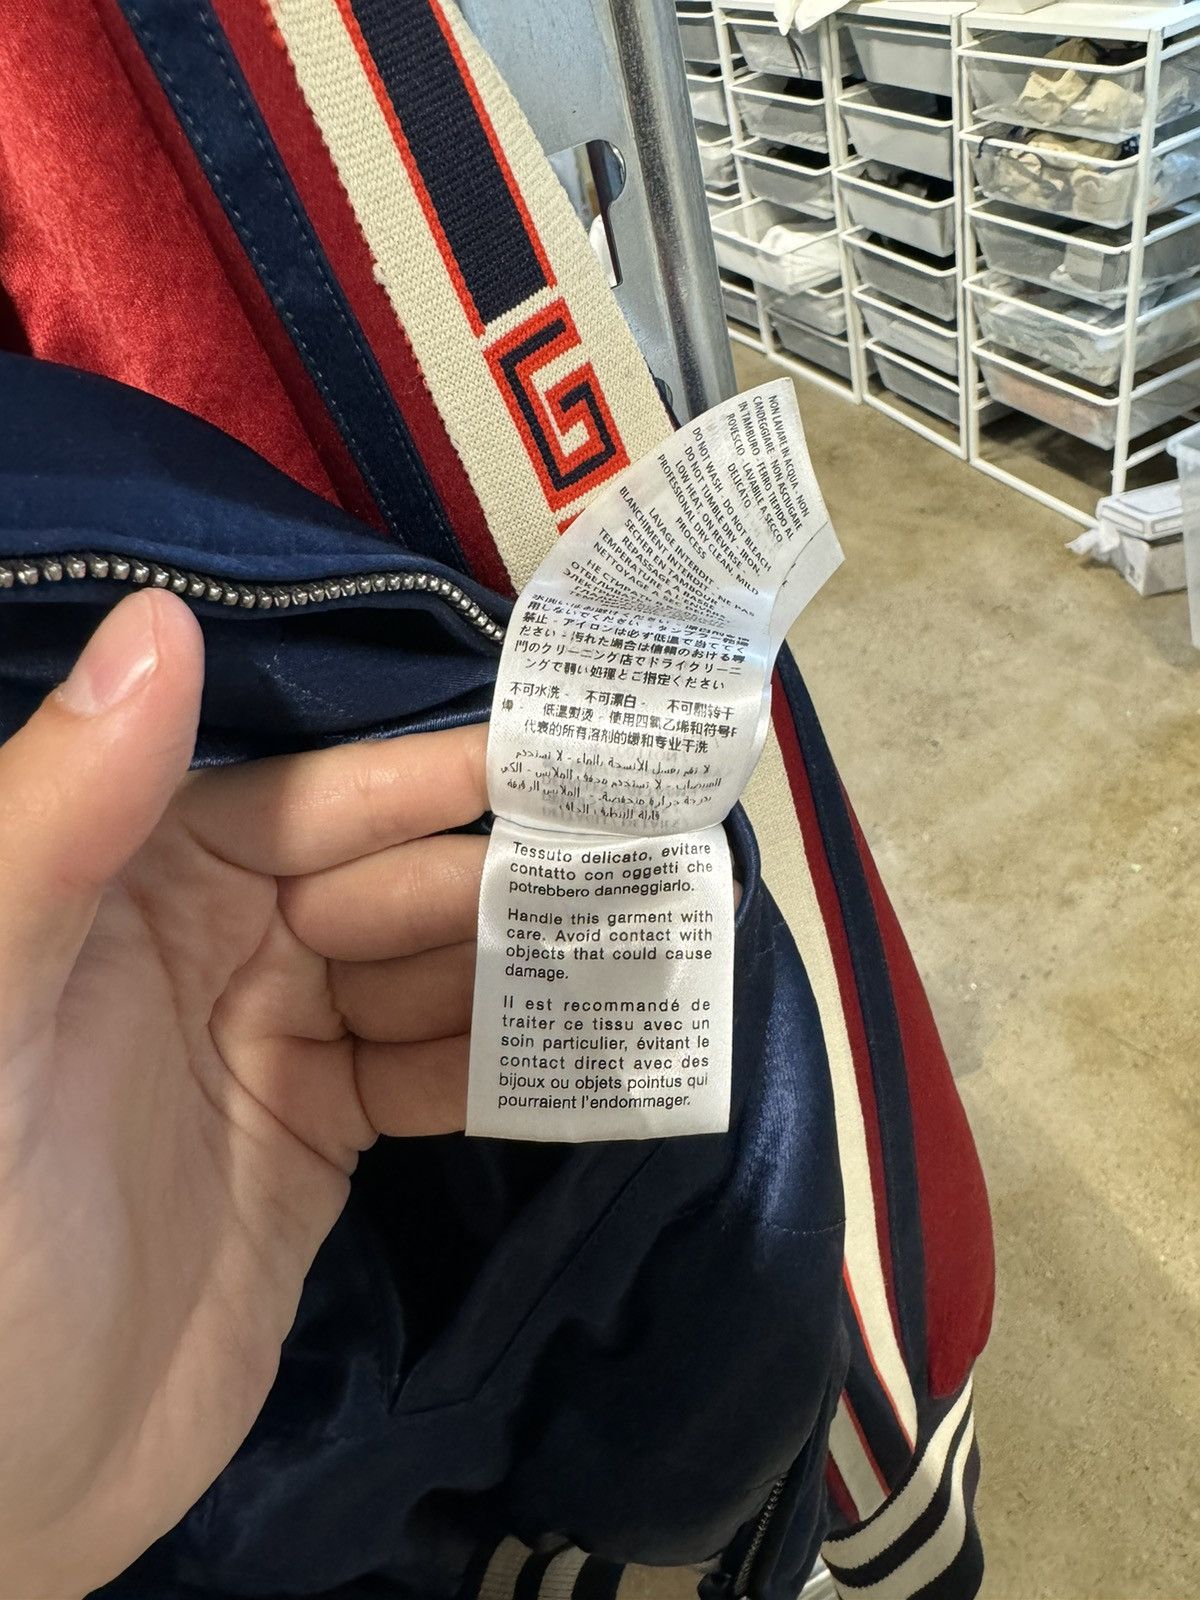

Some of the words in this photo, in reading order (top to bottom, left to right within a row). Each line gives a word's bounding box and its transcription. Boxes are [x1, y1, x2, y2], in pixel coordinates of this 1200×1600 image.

[738, 401, 748, 412] IN
[768, 395, 780, 415] NON
[741, 411, 760, 456] TAMBURO
[772, 415, 788, 448] LAVARE
[753, 396, 775, 454] CANDEGGIARE
[771, 459, 784, 482] NON
[778, 482, 803, 531] ASCIUGARE
[781, 447, 790, 458] IN
[727, 413, 746, 456] ROVESCIO
[743, 462, 764, 505] LAVABILE
[760, 505, 768, 514] A
[765, 513, 783, 542] SECCO
[728, 462, 751, 508] DELICATO
[757, 462, 772, 491] FERRO
[784, 458, 799, 489] ACQUA
[684, 446, 696, 461] DO
[691, 461, 705, 483] NOT
[702, 484, 725, 524] TUMBLE
[722, 522, 737, 543] DRY
[692, 427, 703, 441] DO
[698, 441, 711, 461] NOT
[706, 461, 724, 493] WASH
[723, 499, 735, 515] DO
[731, 514, 747, 537] NOT
[744, 536, 772, 572] BLEACH
[796, 494, 810, 517] NON
[675, 460, 691, 483] LOW
[702, 513, 715, 531] ON
[712, 529, 742, 569] REVERSE
[768, 491, 788, 527] TIEPIDO
[657, 454, 696, 523] PROFESSIONAL
[694, 522, 710, 543] DRY
[736, 574, 759, 595] MILD
[676, 516, 707, 559] PROCESS
[785, 527, 794, 539] AL
[599, 527, 663, 590] TEMPERATURE
[620, 486, 668, 555] BLANCHIMENT
[667, 554, 709, 592] INTERDIT
[718, 595, 732, 606] NE
[649, 507, 676, 547] LAVAGE
[674, 545, 715, 586] INTERDIT
[587, 559, 602, 574] НЕ
[593, 541, 650, 590] NETTOYAGE
[622, 536, 671, 586] REPASSAGE
[673, 585, 681, 593] A
[683, 591, 715, 611] BASSE
[624, 518, 654, 557] SECHER
[653, 555, 667, 570] EN
[667, 568, 719, 606] TAMBOUR
[510, 681, 560, 700] 不可水洗
[585, 690, 637, 709] 不可漂白
[513, 841, 572, 863] Tessuto
[581, 851, 653, 865] delicato,
[661, 843, 711, 858] evitare
[510, 862, 576, 882] contatto
[584, 870, 614, 881] con
[622, 863, 679, 879] oggetti
[687, 860, 713, 873] che
[508, 881, 590, 898] potrebbero
[594, 880, 695, 897] danneggiarlo.
[507, 908, 563, 925] Handle
[571, 911, 600, 925] this
[607, 911, 673, 927] garment
[681, 909, 713, 923] with
[506, 928, 546, 942] care.
[555, 929, 601, 942] Avoid
[609, 930, 671, 942] contact
[679, 928, 713, 941] with
[506, 946, 565, 961] objects
[573, 948, 605, 960] that
[612, 947, 657, 960] could
[665, 949, 712, 960] cause
[505, 965, 569, 982] damage.
[503, 995, 514, 1009] Il
[525, 999, 553, 1011] est
[563, 998, 680, 1012] recommandé
[691, 999, 711, 1011] de
[502, 1014, 555, 1030] traiter
[564, 1019, 584, 1030] ce
[592, 1017, 634, 1031] tissu
[643, 1019, 683, 1031] avec
[692, 1018, 710, 1030] un
[501, 1035, 535, 1048] soin
[543, 1036, 629, 1052] particulier,
[636, 1035, 690, 1050] évitant
[697, 1034, 710, 1048] le
[500, 1055, 565, 1069] contact
[574, 1056, 625, 1070] direct
[633, 1058, 673, 1069] avec
[681, 1054, 709, 1068] des
[499, 1074, 546, 1090] bijoux
[551, 1078, 569, 1089] ou
[575, 1075, 622, 1090] objets
[627, 1075, 682, 1092] pointus
[687, 1074, 708, 1088] qui
[498, 1095, 577, 1110] pourraient
[581, 1094, 691, 1110] l'endommager.
